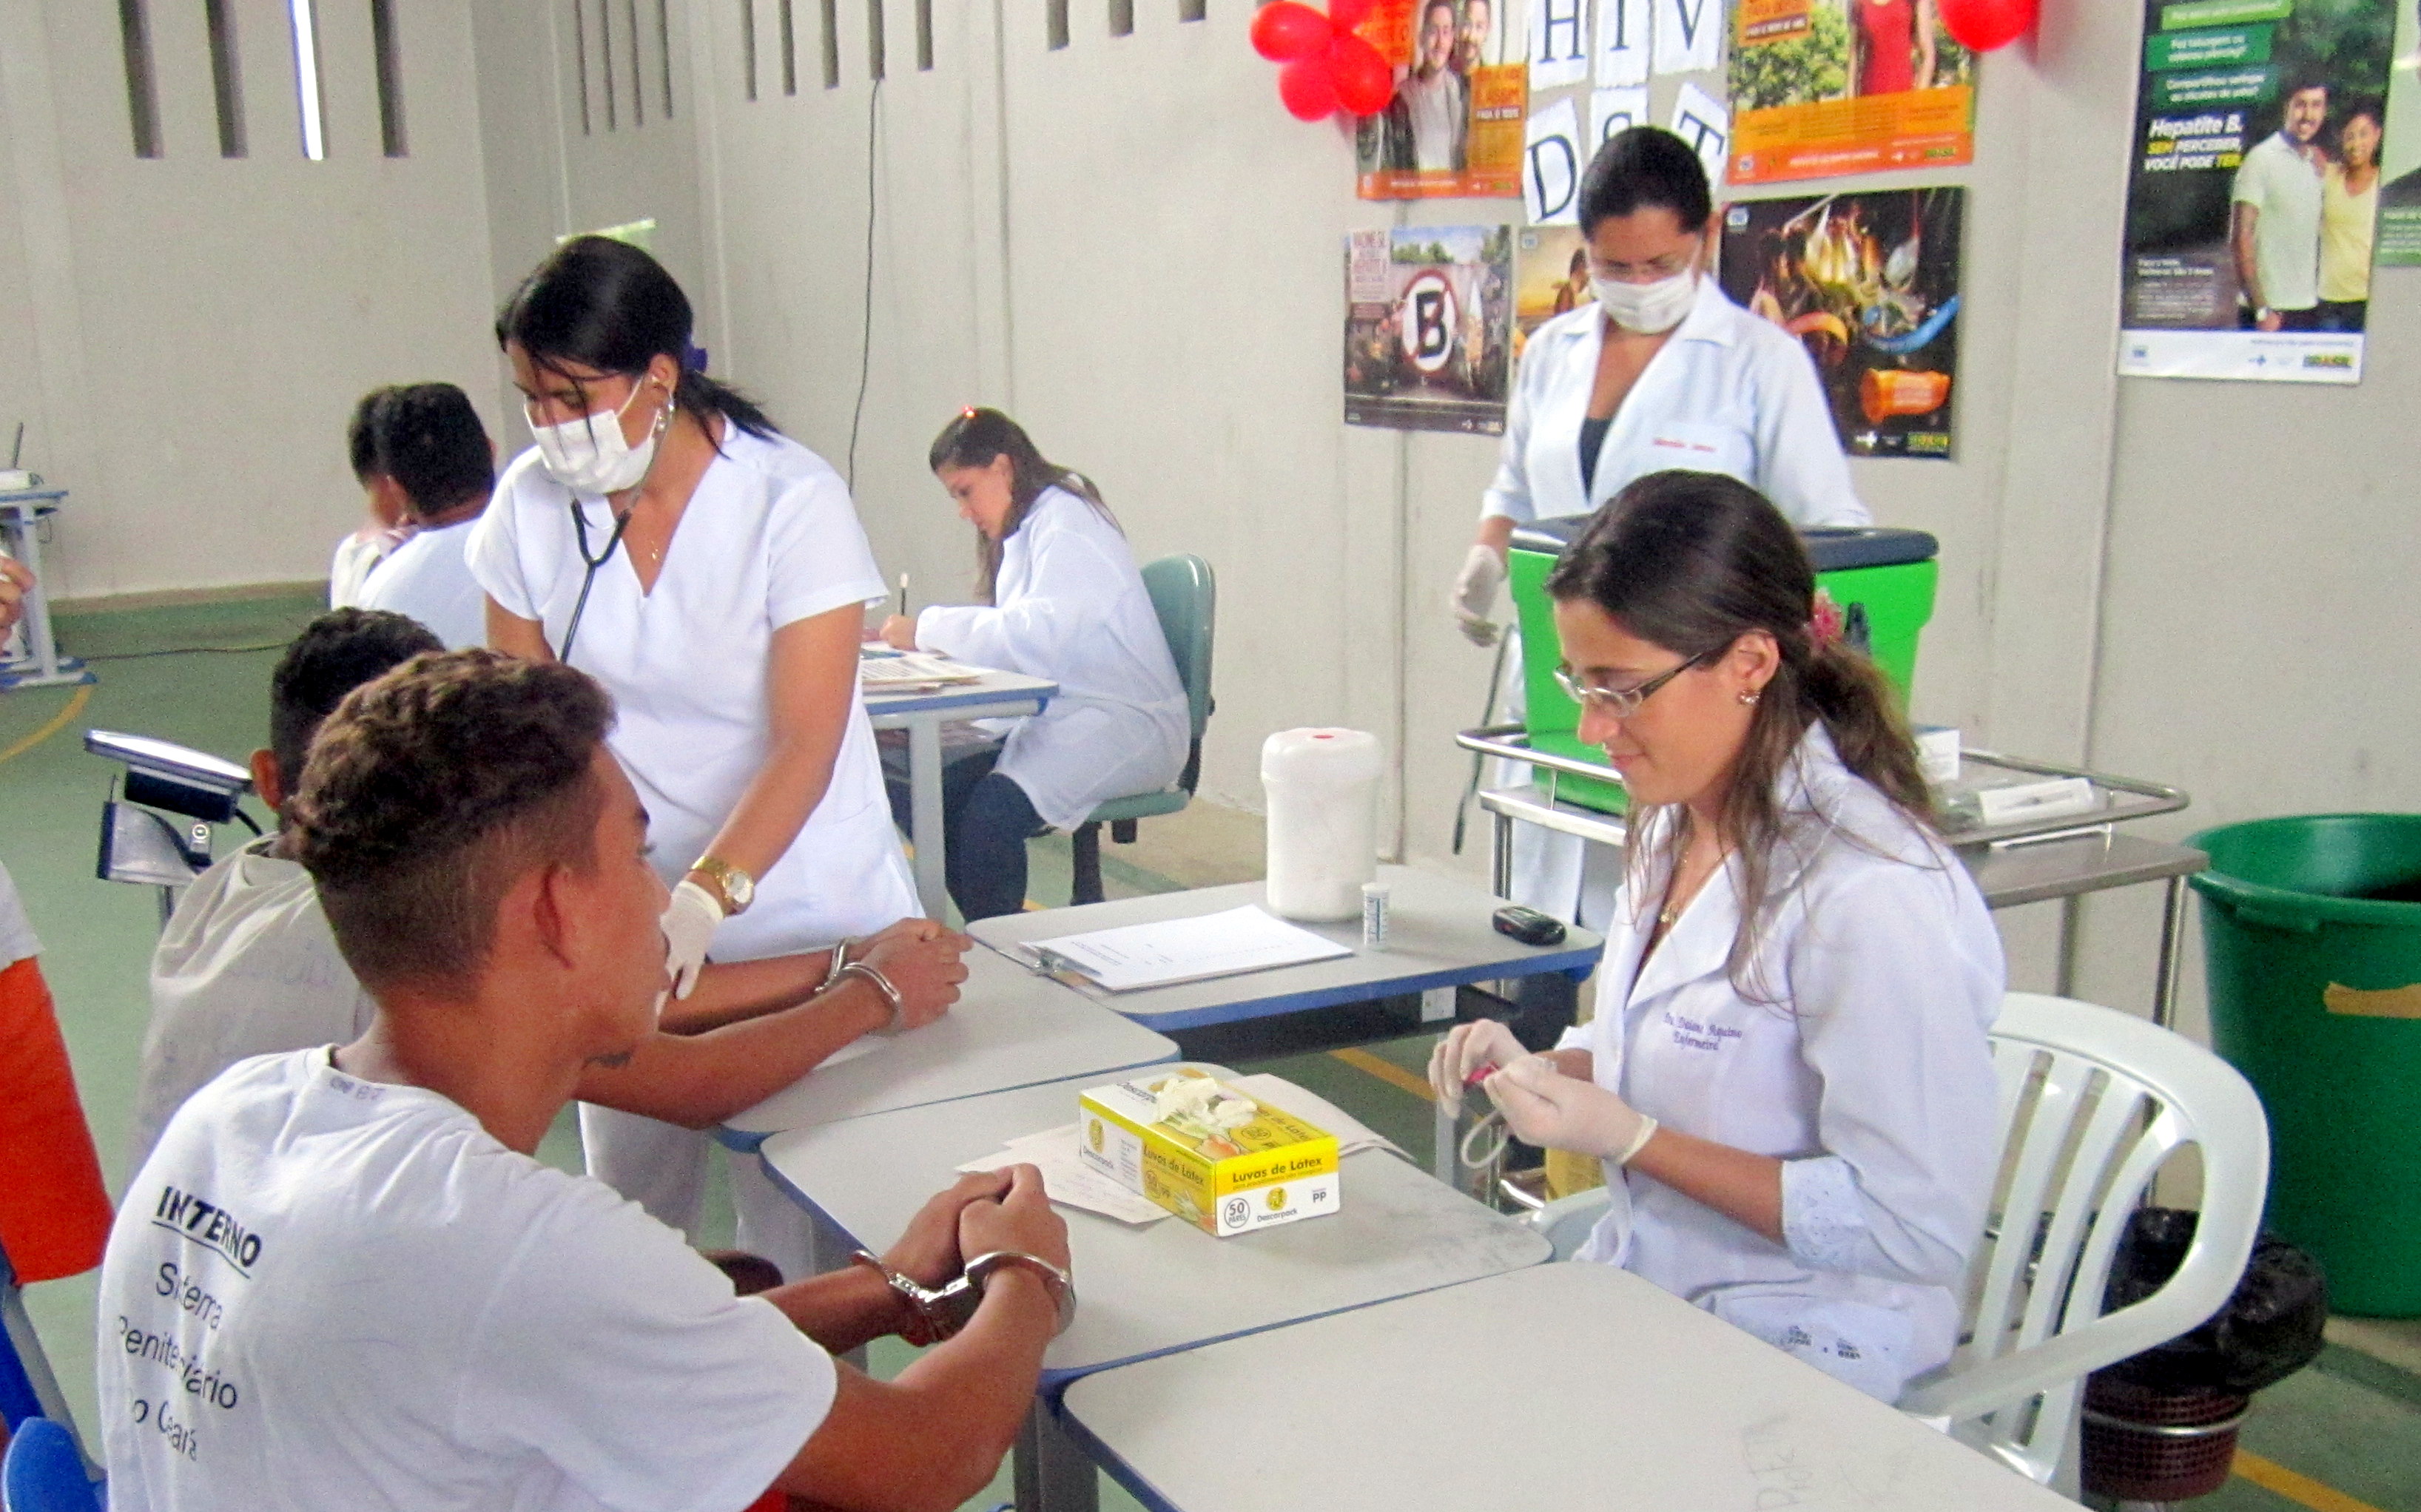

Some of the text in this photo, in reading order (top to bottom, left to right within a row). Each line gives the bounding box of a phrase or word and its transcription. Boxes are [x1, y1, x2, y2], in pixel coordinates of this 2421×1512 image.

[1416, 289, 1448, 359] B
[1232, 1157, 1323, 1184] Luvas de Látex
[1229, 1201, 1245, 1216] 50
[1313, 1191, 1327, 1203] PP
[156, 1186, 262, 1267] INTERNO
